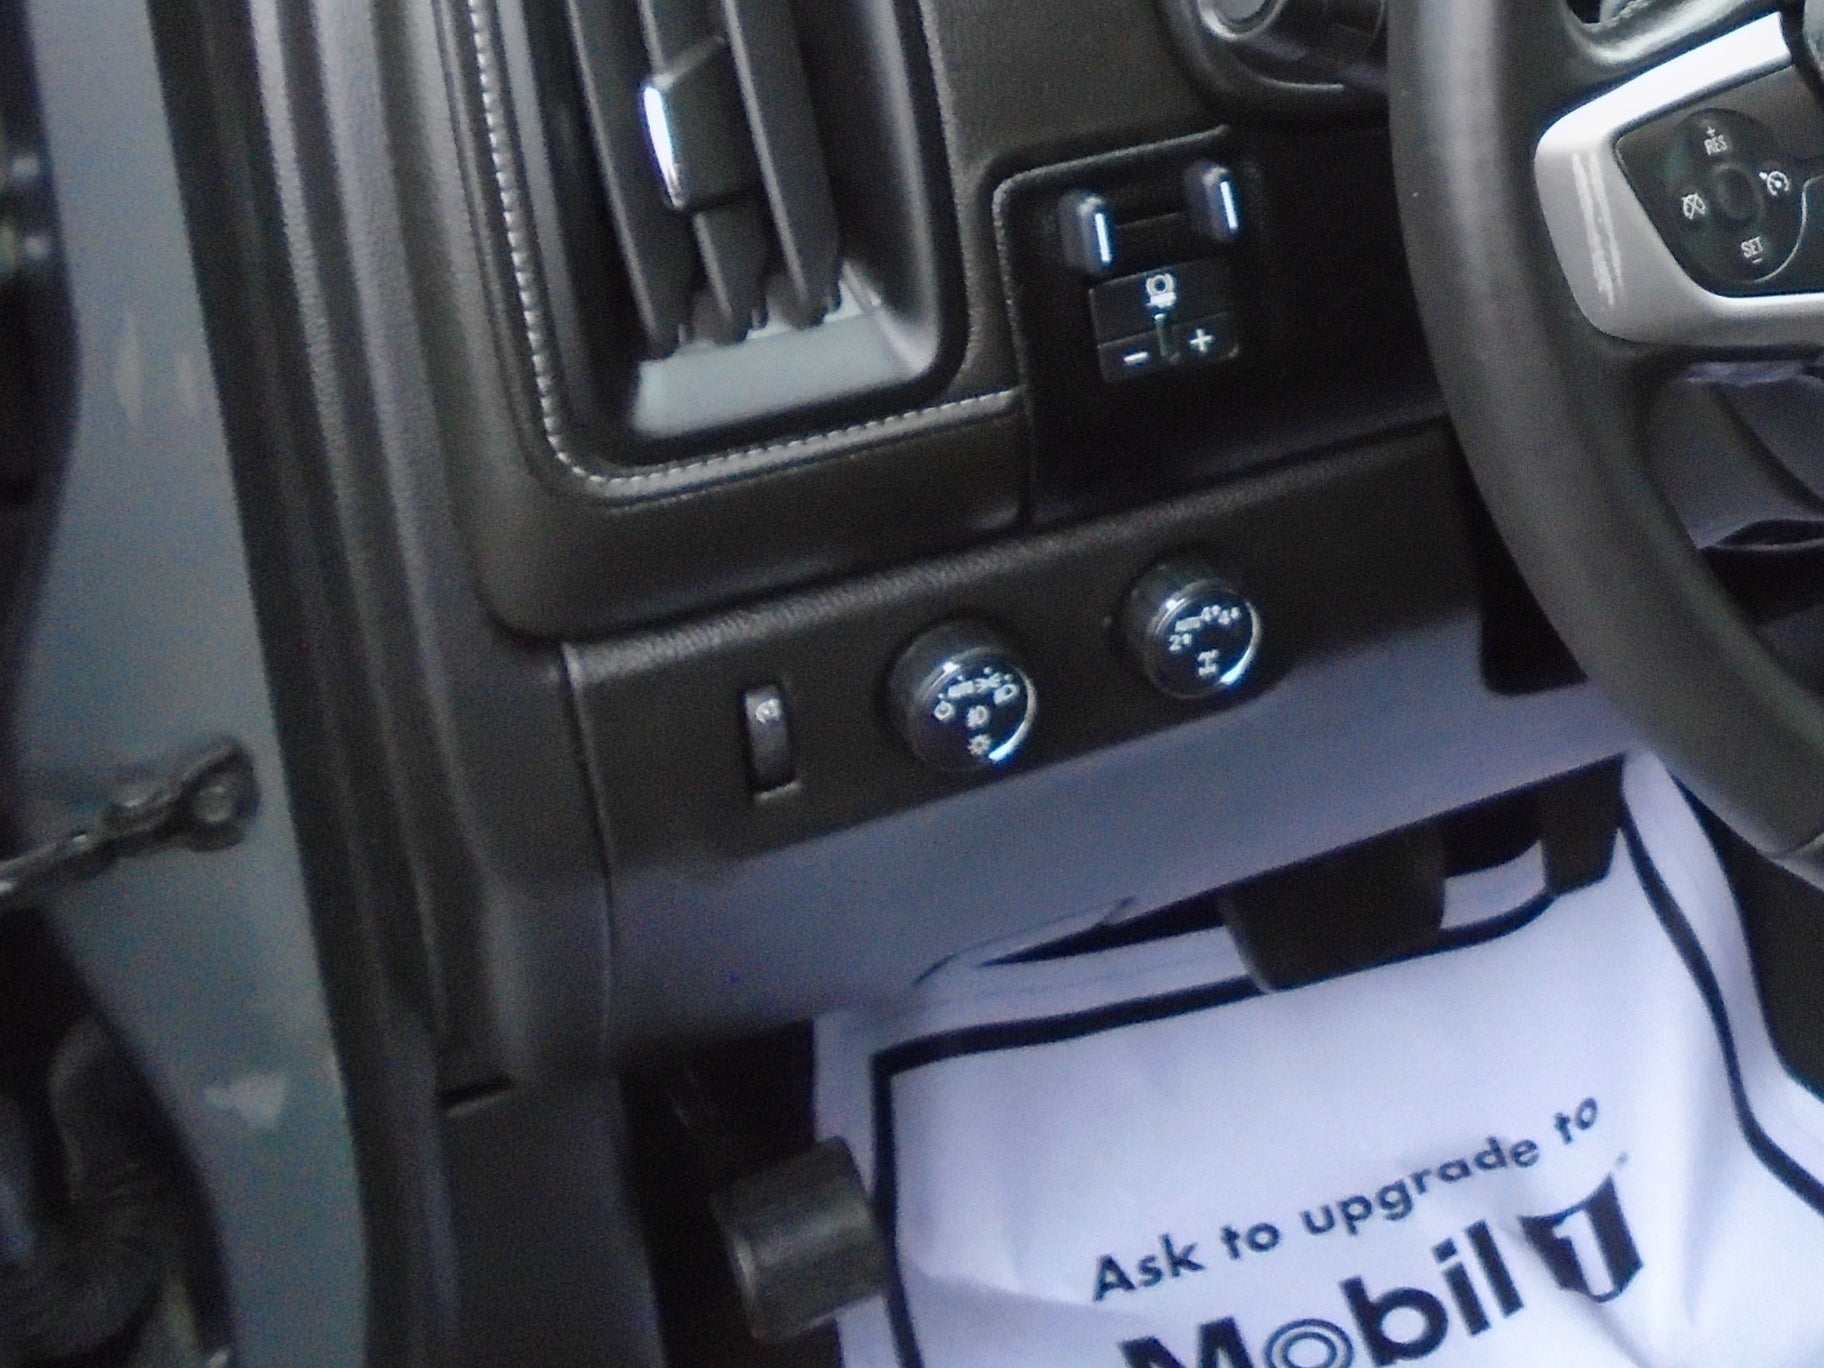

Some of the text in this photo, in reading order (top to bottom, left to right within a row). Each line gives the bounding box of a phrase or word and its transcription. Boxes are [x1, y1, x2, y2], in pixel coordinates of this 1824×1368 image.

[1704, 135, 1728, 157] RES
[1741, 236, 1763, 258] SET
[1093, 1097, 1598, 1302] Ask to upgrade to
